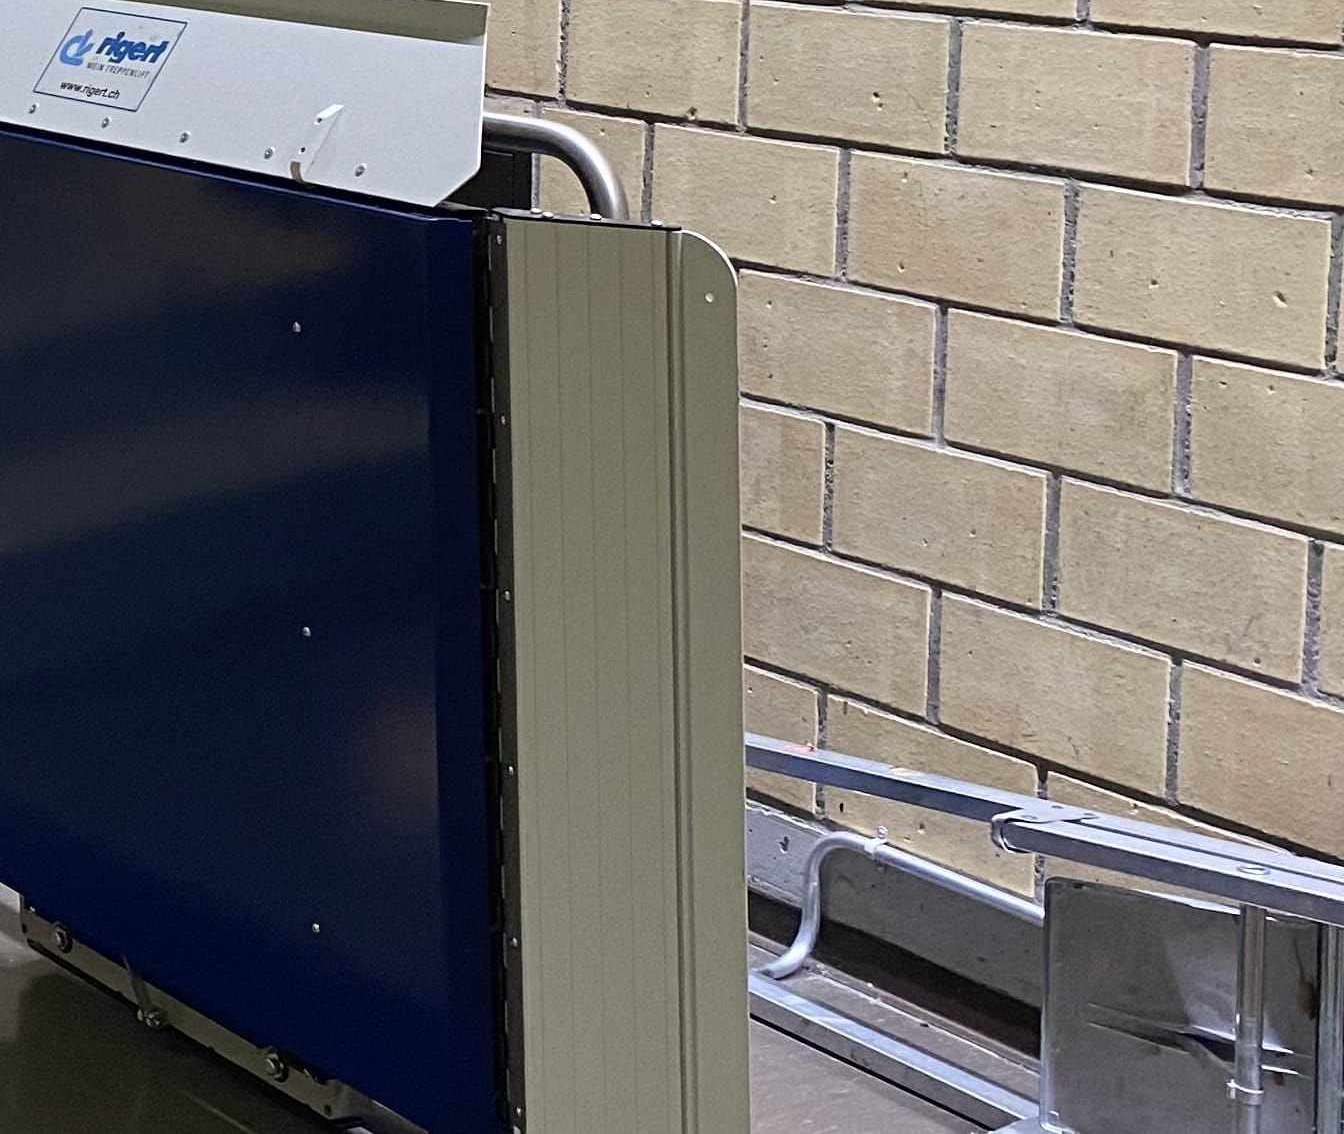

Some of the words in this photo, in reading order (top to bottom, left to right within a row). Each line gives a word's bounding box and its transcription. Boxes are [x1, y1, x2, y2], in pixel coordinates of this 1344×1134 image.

[96, 32, 169, 63] rigert
[87, 62, 104, 71] MEIN
[105, 65, 150, 79] TREPPENLIFT
[60, 81, 120, 99] www.rigert.ch
